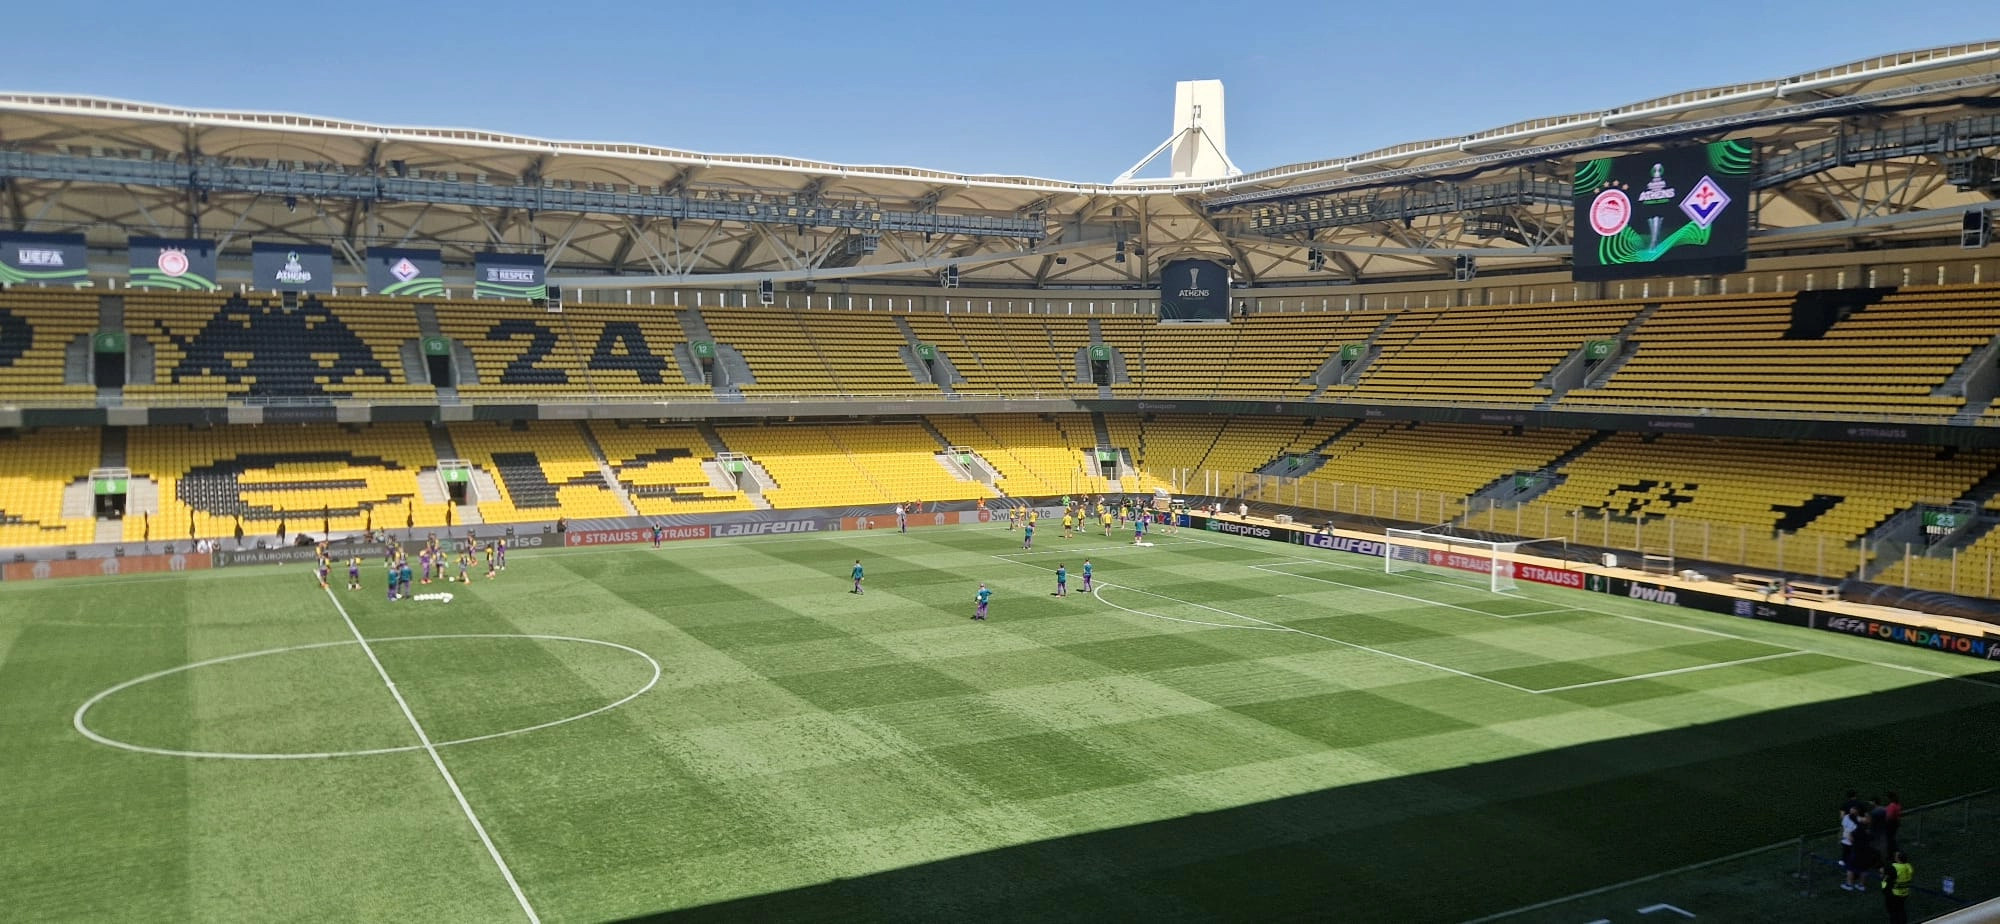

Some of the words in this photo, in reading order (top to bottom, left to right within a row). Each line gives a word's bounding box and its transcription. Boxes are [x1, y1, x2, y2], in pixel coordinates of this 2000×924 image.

[18, 250, 64, 266] UEFA
[275, 270, 311, 282] ATHENS
[499, 271, 534, 281] RESPECT
[1178, 289, 1210, 297] ATHENS
[430, 341, 443, 351] 10
[698, 345, 707, 354] 12
[1594, 345, 1608, 354] 20
[991, 508, 1051, 521] Swisute
[1936, 515, 1955, 527] 23
[659, 527, 706, 539] TRAUSS
[1208, 520, 1271, 538] enterprise
[585, 531, 638, 543] STRAUSS
[439, 535, 542, 553] enerprise
[234, 554, 258, 563] UEFA
[259, 551, 292, 562] EUROPA
[293, 548, 348, 559] CONFNCE
[351, 546, 382, 554] LEAGUE
[1447, 554, 1498, 573] STRAUS
[1521, 563, 1579, 586] STRAUSS
[1628, 582, 1678, 605] bwin
[1827, 616, 1866, 634] UEFA
[1868, 622, 1986, 655] FOUNDATION
